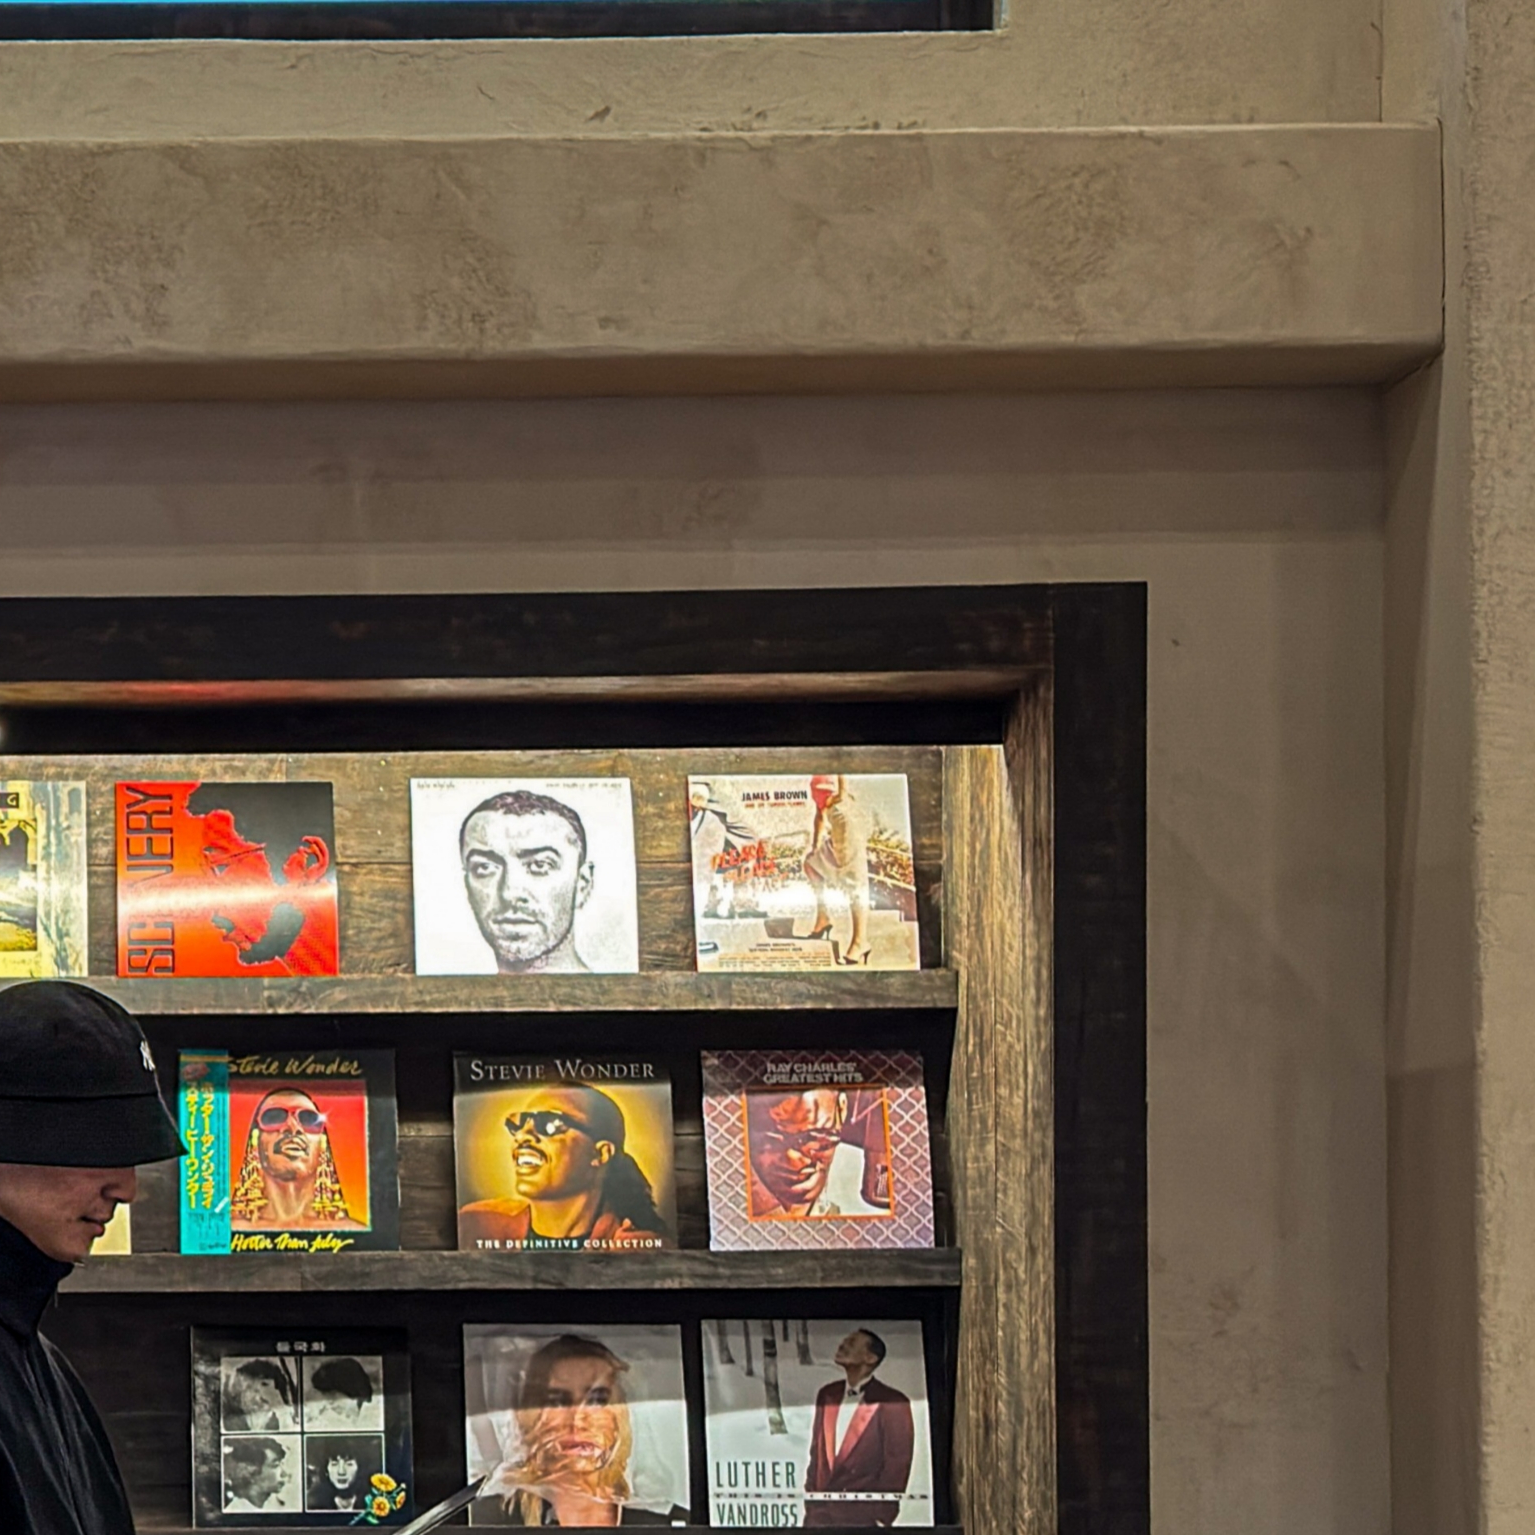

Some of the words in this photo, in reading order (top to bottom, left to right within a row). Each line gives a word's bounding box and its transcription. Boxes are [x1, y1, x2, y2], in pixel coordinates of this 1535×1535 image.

[742, 791, 770, 802] JAMES
[773, 790, 807, 800] BROWN
[285, 1055, 363, 1075] Wonder
[766, 1062, 793, 1073] RAY
[763, 1072, 832, 1084] GREATEST
[833, 1072, 864, 1083] HITS
[476, 1240, 501, 1249] THE
[506, 1239, 578, 1249] DEFINITIVE
[583, 1239, 662, 1249] COLLECTION
[716, 1461, 796, 1488] LUTHER
[717, 1503, 798, 1528] VANDROSS
